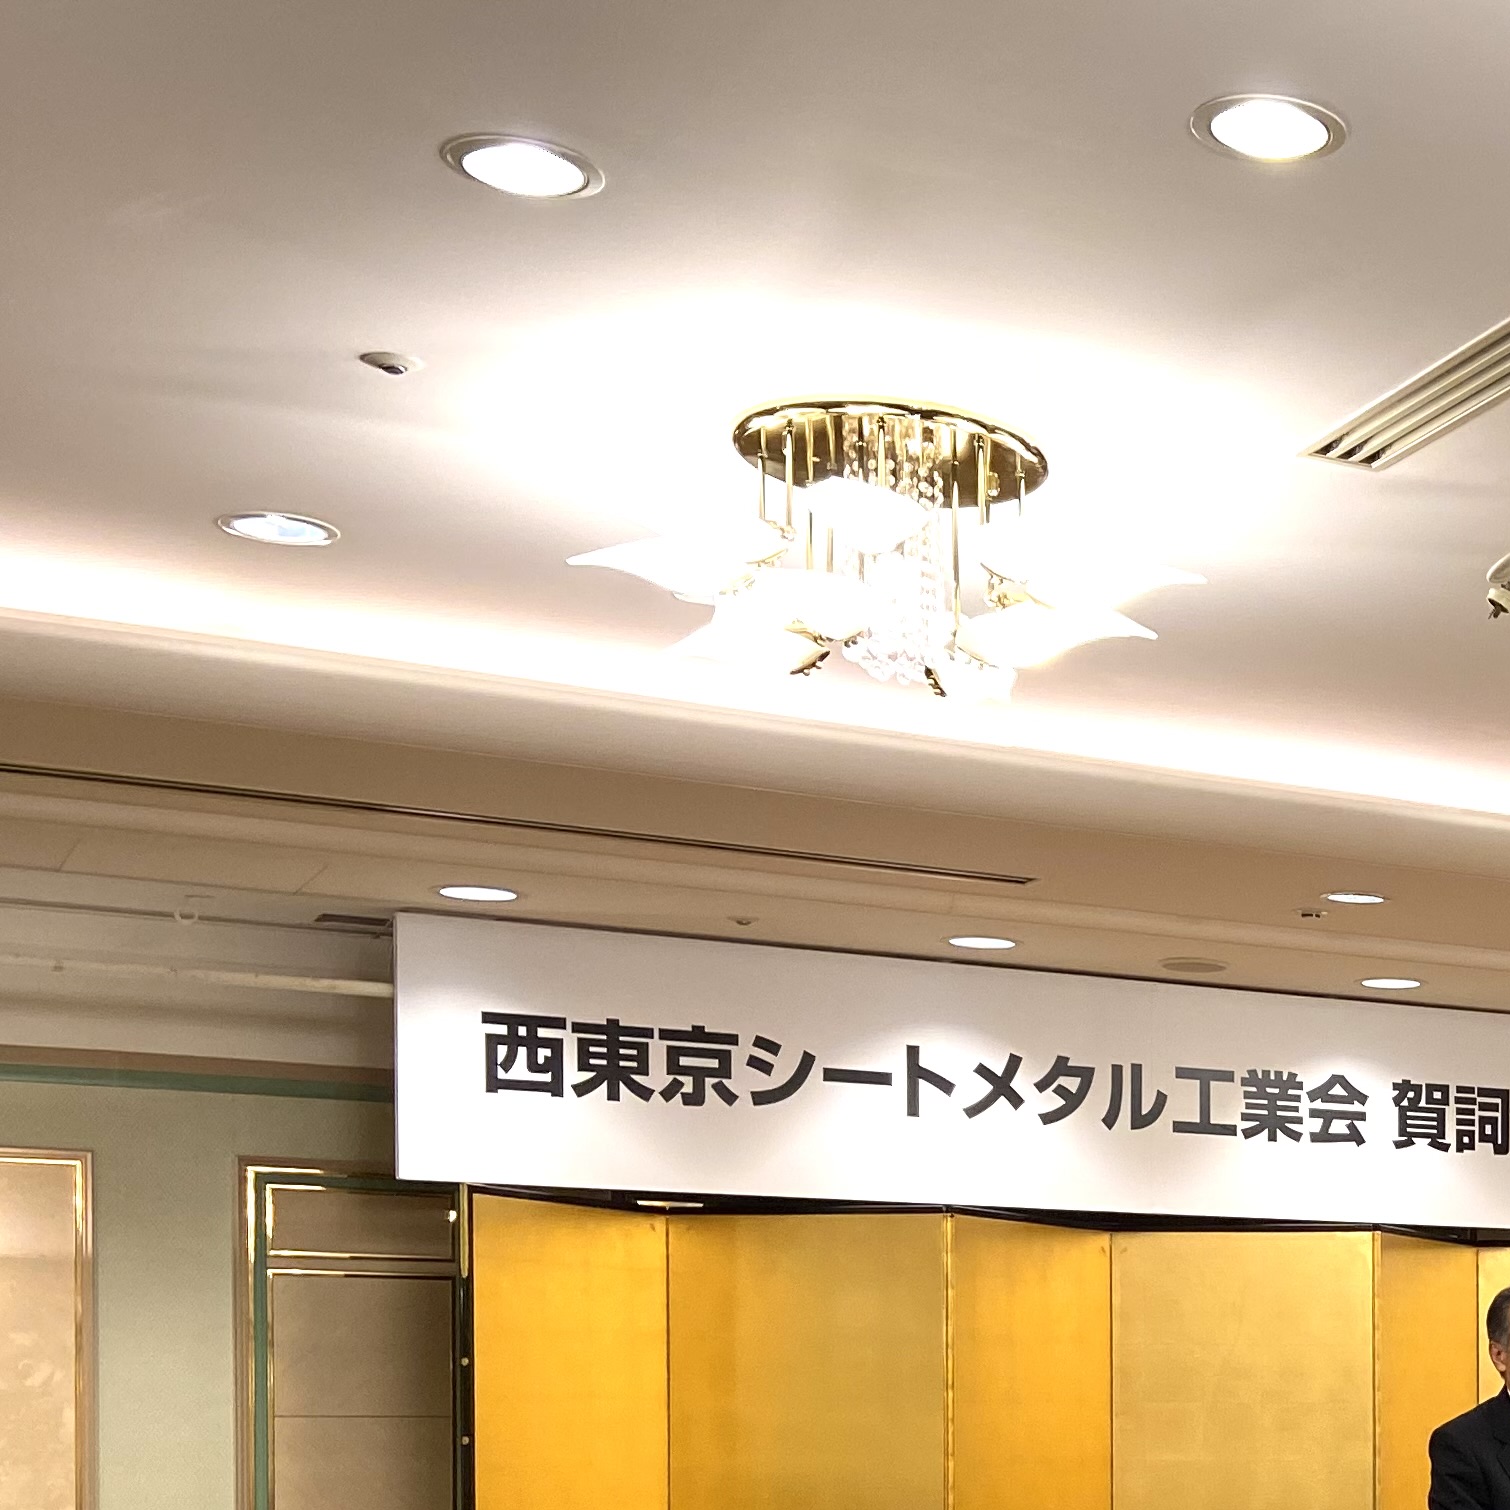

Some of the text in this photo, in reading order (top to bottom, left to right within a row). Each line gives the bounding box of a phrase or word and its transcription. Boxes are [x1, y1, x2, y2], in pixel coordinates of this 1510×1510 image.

[481, 1011, 1368, 1147] 西東京シートメタル工業会
